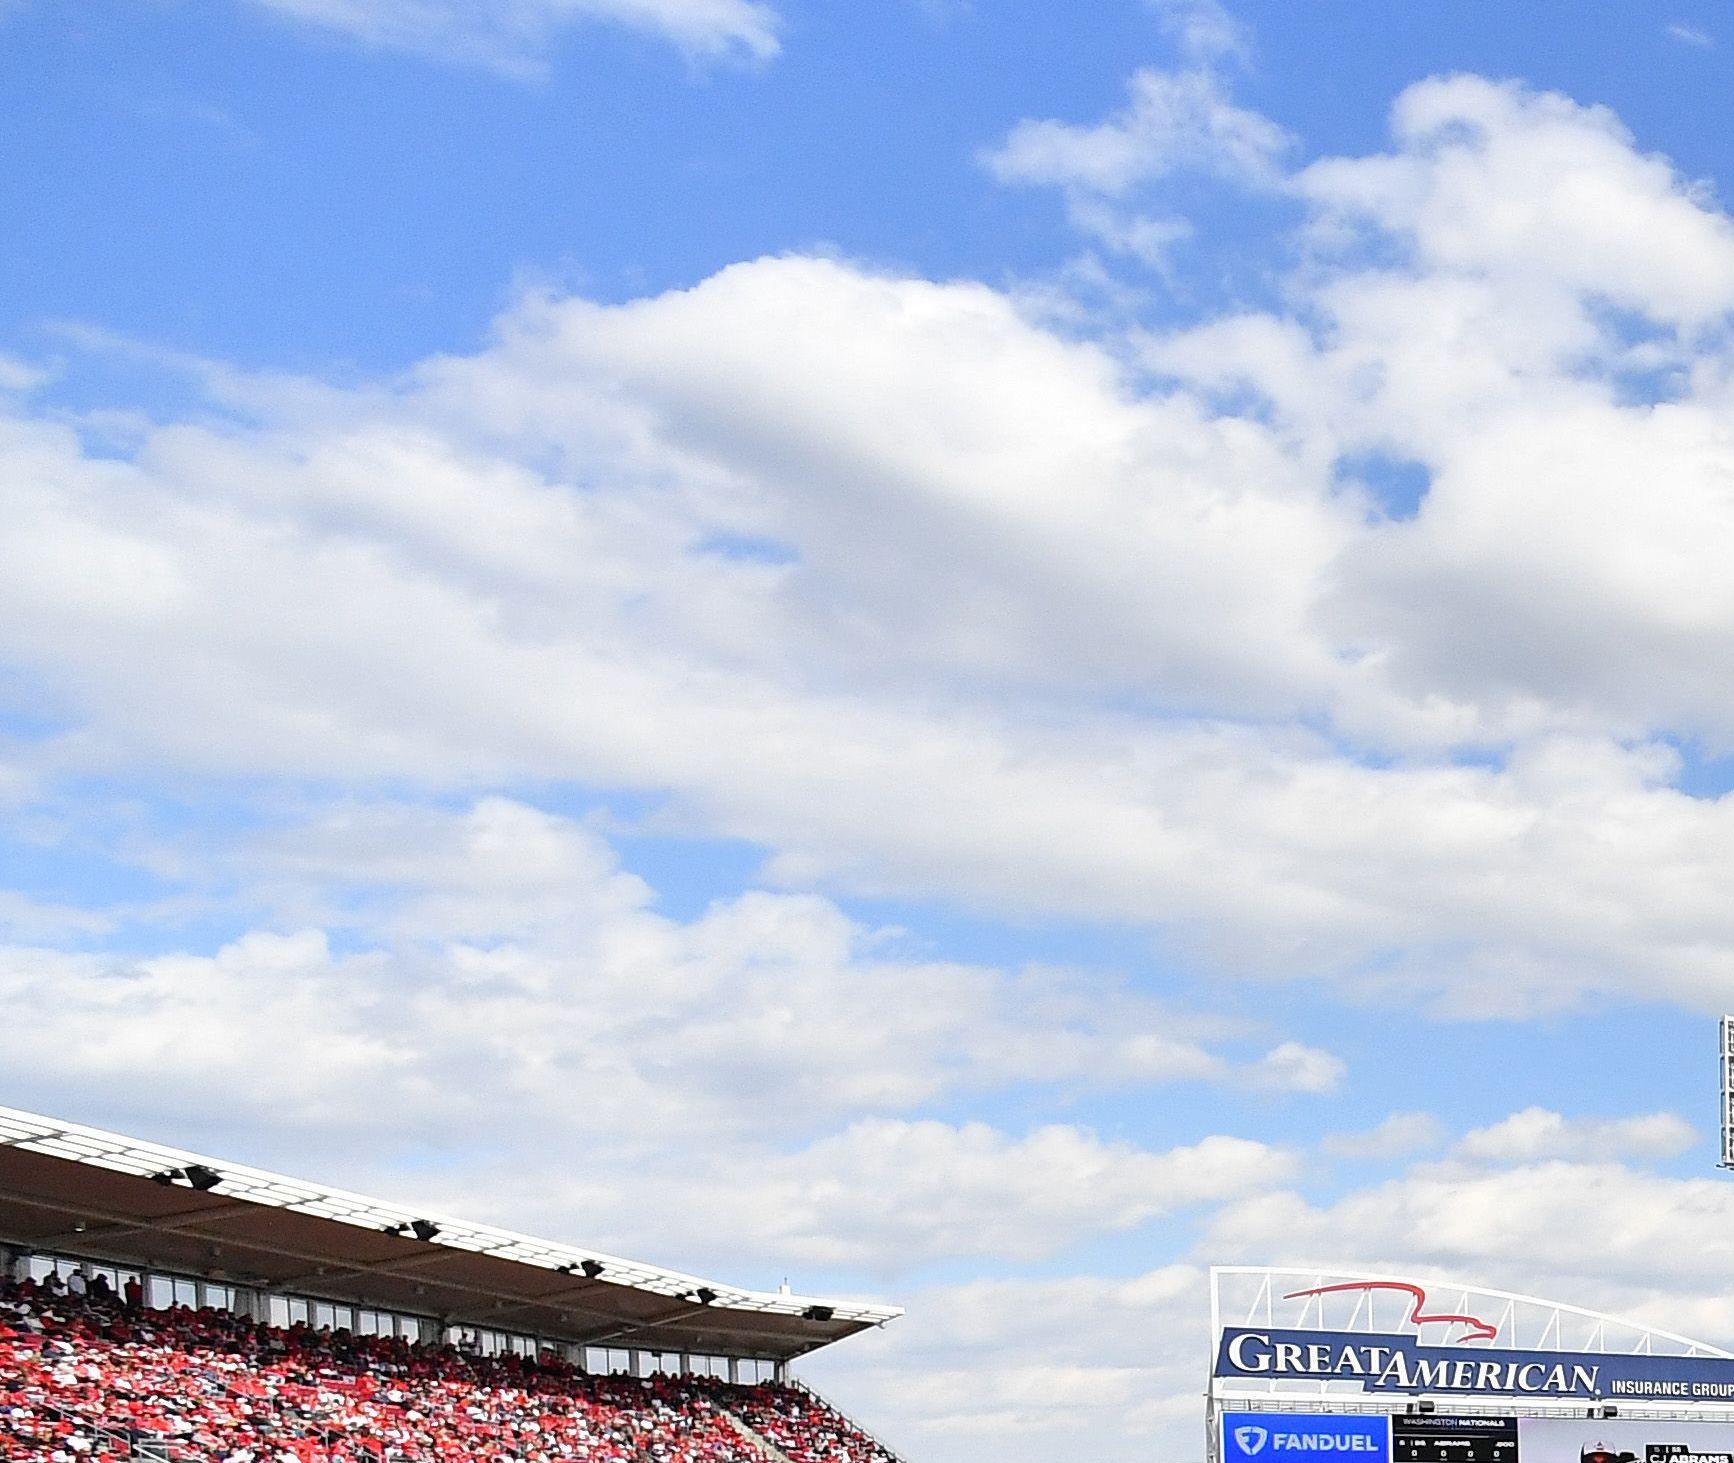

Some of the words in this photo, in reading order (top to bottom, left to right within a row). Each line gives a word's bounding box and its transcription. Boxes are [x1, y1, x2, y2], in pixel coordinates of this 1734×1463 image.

[1229, 1335, 1388, 1374] GREAT
[1375, 1351, 1600, 1394] AMERICAN
[1611, 1380, 1688, 1395] INSURANCE
[1459, 1419, 1505, 1427] NATIONALS
[1272, 1432, 1379, 1453] FANDUEL
[1649, 1454, 1667, 1463] CJ
